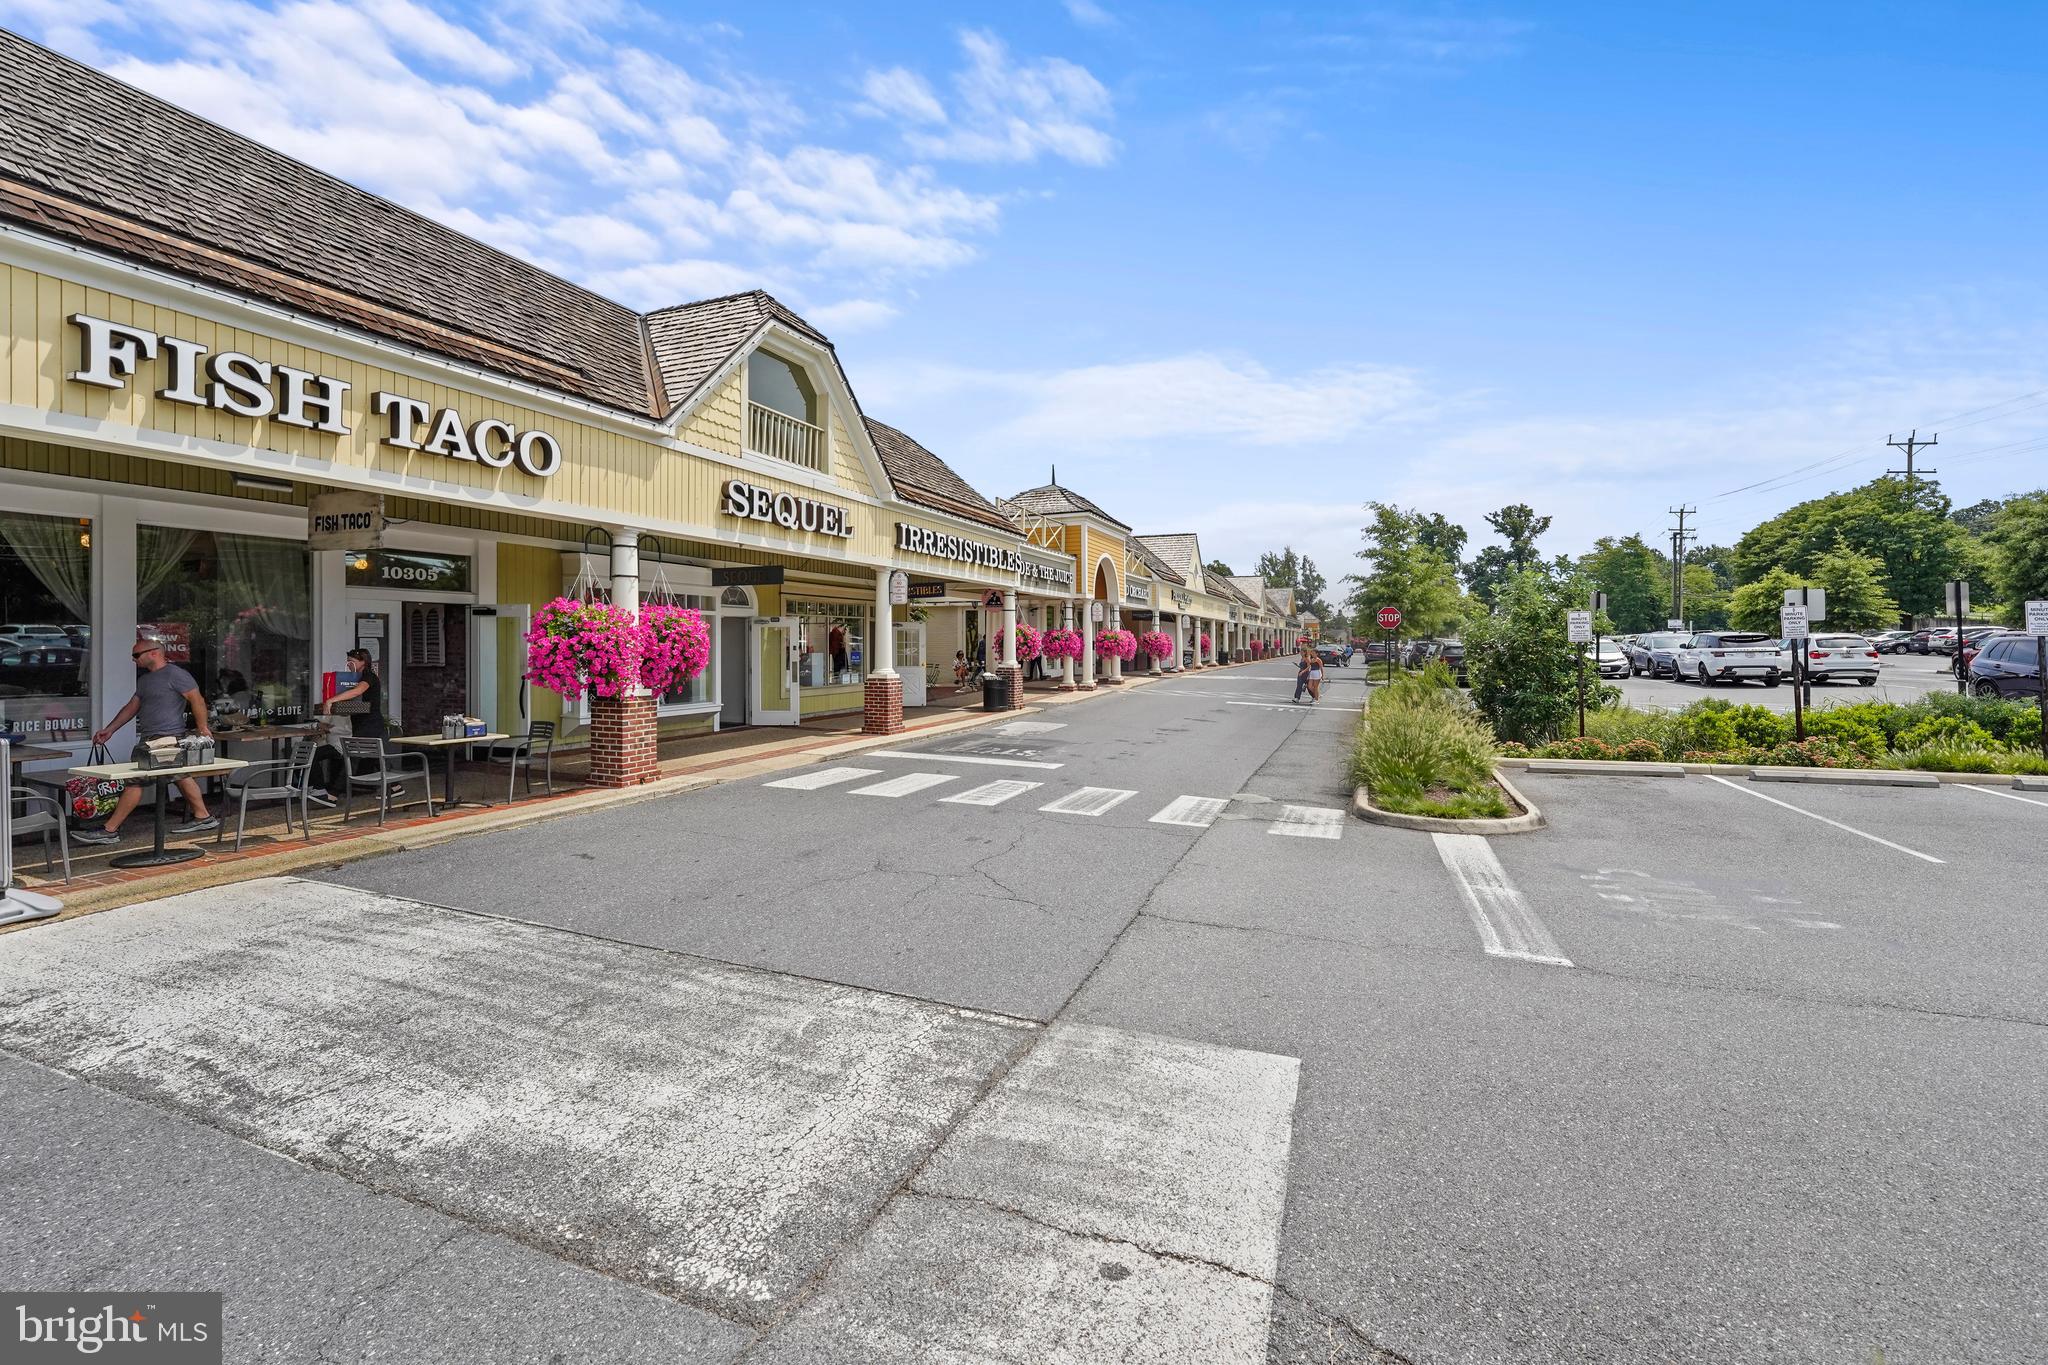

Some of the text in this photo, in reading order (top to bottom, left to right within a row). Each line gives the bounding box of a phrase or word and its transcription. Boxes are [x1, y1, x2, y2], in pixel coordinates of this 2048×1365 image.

[67, 313, 562, 477] FISH TACO
[722, 480, 855, 539] SEQUEL
[315, 512, 371, 532] FISH TACO
[895, 522, 1022, 573] IRRESISTIBLES
[382, 566, 438, 581] 10305
[721, 570, 767, 584] SEQUE
[1032, 563, 1038, 578] &
[1039, 565, 1054, 580] THE
[1054, 568, 1073, 584] JUICE
[1378, 612, 1400, 623] STOP
[277, 705, 302, 716] ELOTE
[13, 718, 84, 732] RICE BOWLS
